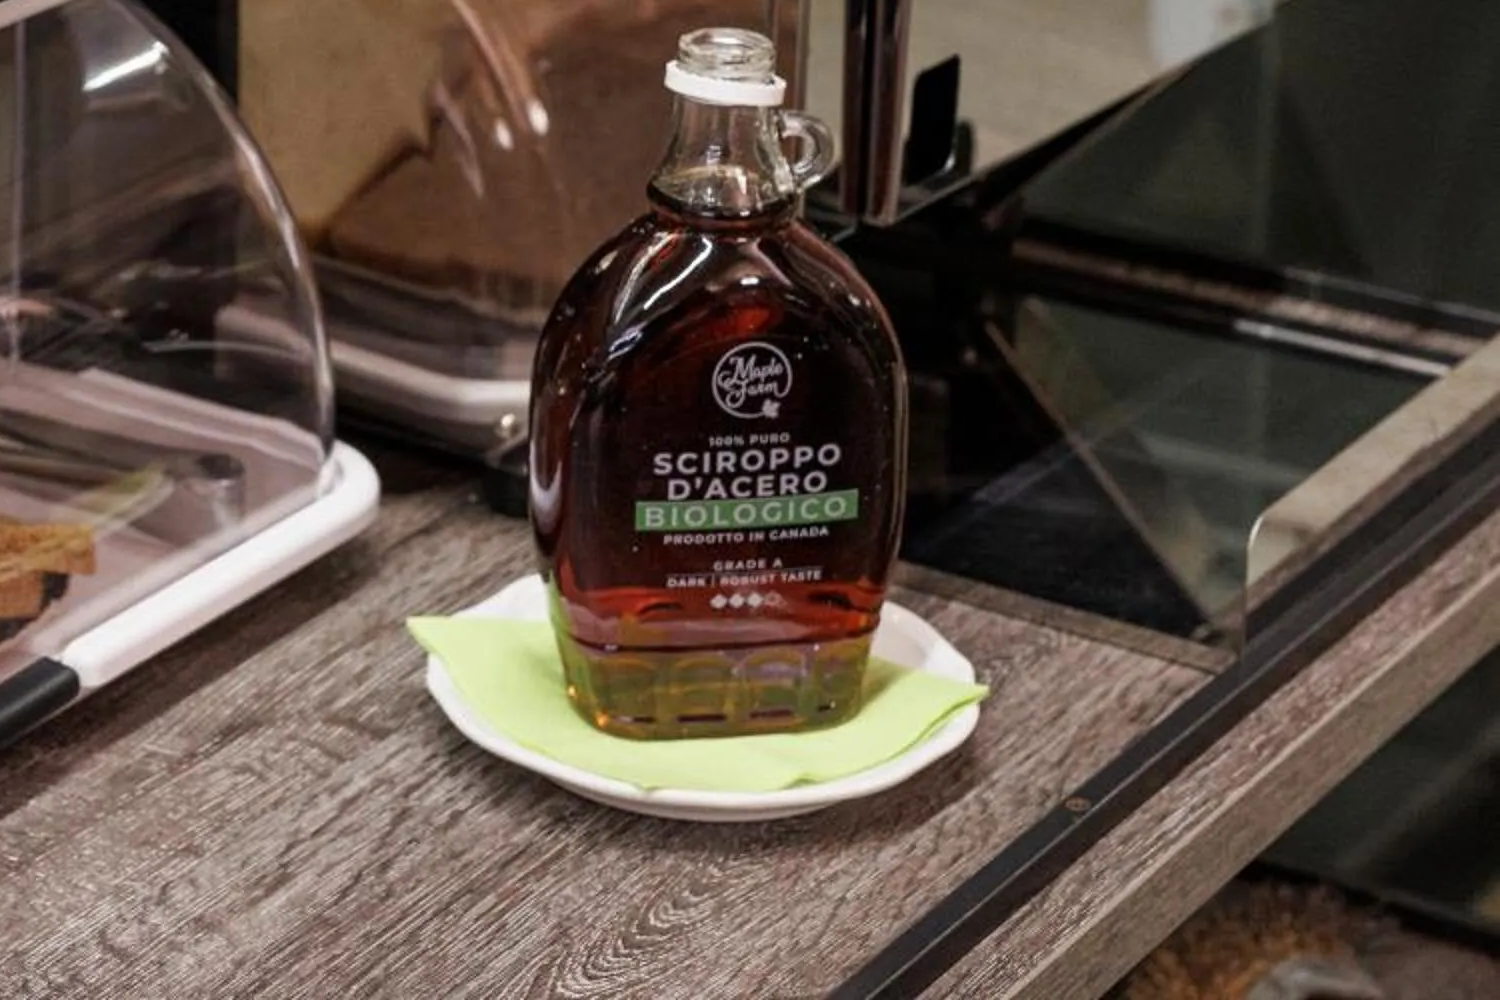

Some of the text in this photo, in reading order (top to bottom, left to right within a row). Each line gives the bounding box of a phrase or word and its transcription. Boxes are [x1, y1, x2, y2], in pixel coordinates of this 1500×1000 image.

[719, 354, 784, 389] Maple
[726, 379, 780, 408] Farm
[709, 432, 791, 447] 100% PURO
[653, 443, 841, 475] SCIROPPO
[667, 470, 828, 501] D'ACERO
[645, 496, 847, 528] BIOLOGICO
[663, 525, 830, 546] PRODOTTO IN CANADA
[666, 569, 822, 588] DARK ROBUST TASTE
[713, 557, 784, 572] GRADE A
